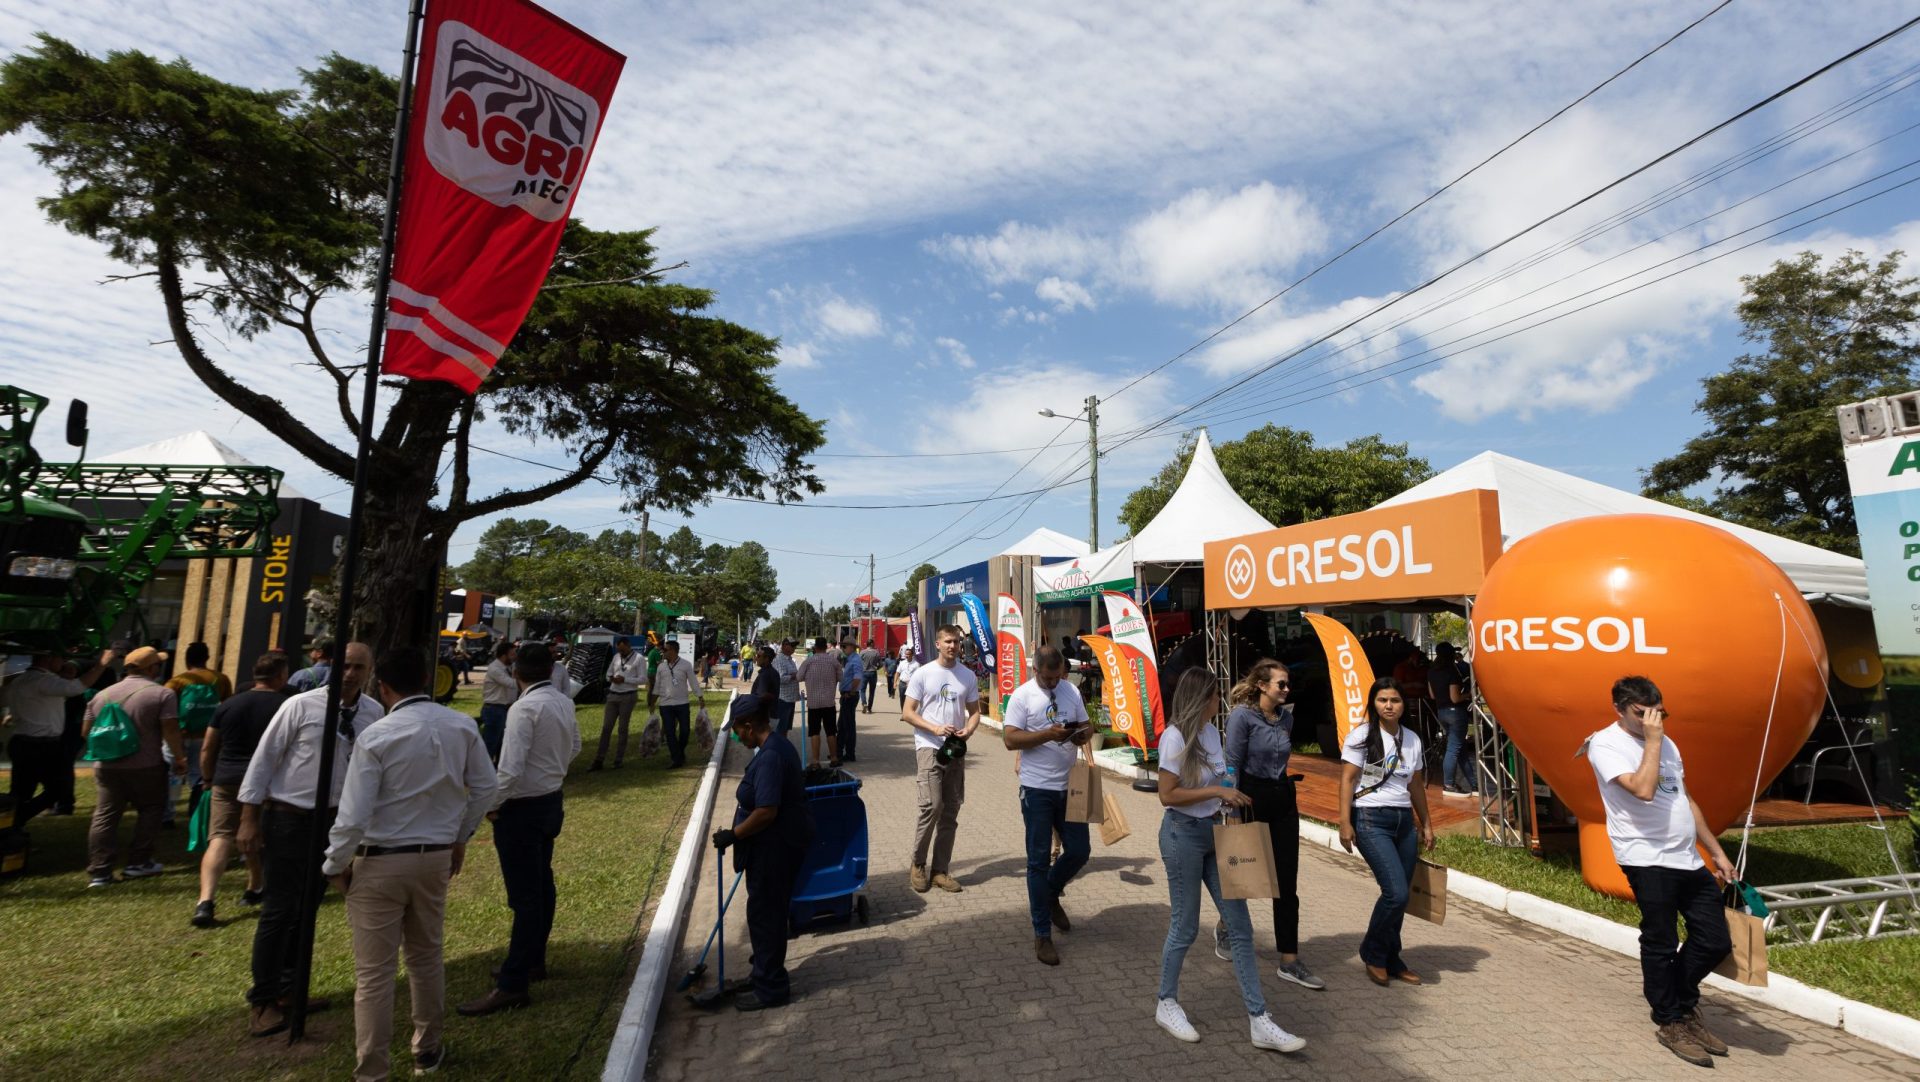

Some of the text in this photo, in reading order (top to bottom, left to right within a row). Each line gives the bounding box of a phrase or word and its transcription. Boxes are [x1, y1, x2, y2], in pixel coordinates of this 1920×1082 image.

[441, 90, 584, 185] AGRI
[512, 179, 569, 204] MEC
[261, 534, 292, 603] STORE
[1053, 570, 1090, 591] GOMES
[1266, 525, 1432, 587] CRESOL
[1113, 620, 1144, 633] GOMES
[1480, 616, 1668, 655] CRESOL
[1103, 644, 1127, 710] CRESOL
[1336, 635, 1364, 733] RESOL
